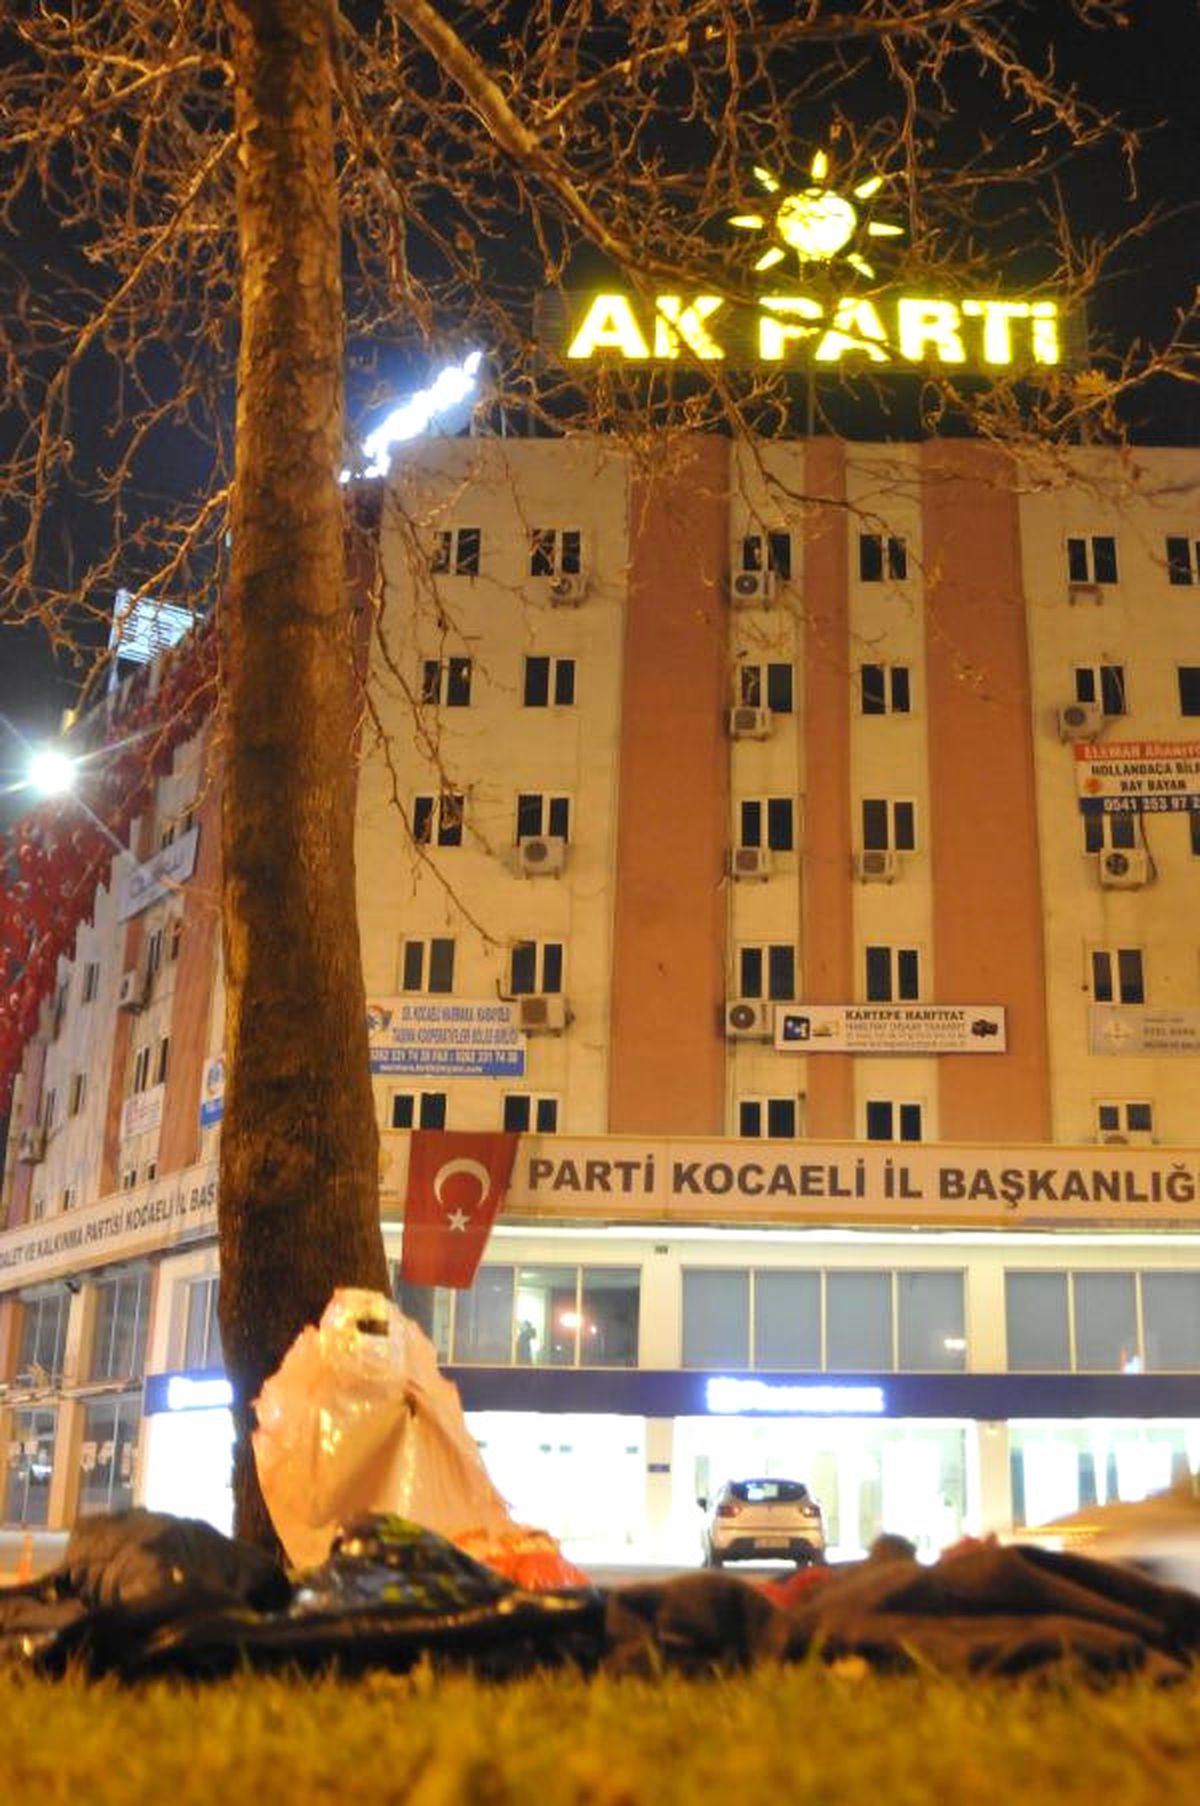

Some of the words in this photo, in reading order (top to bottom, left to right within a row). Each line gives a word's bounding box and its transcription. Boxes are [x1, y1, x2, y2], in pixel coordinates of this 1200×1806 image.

[567, 294, 725, 360] AK
[758, 296, 1060, 365] PARTİ
[126, 1194, 173, 1231] KOCAELİ
[190, 1183, 217, 1214] BAŞ
[528, 1154, 655, 1193] PARTİ
[673, 1159, 866, 1199] KOCAELİ
[884, 1159, 923, 1199] İL
[939, 1161, 1200, 1209] BAŞKANLIĞ
